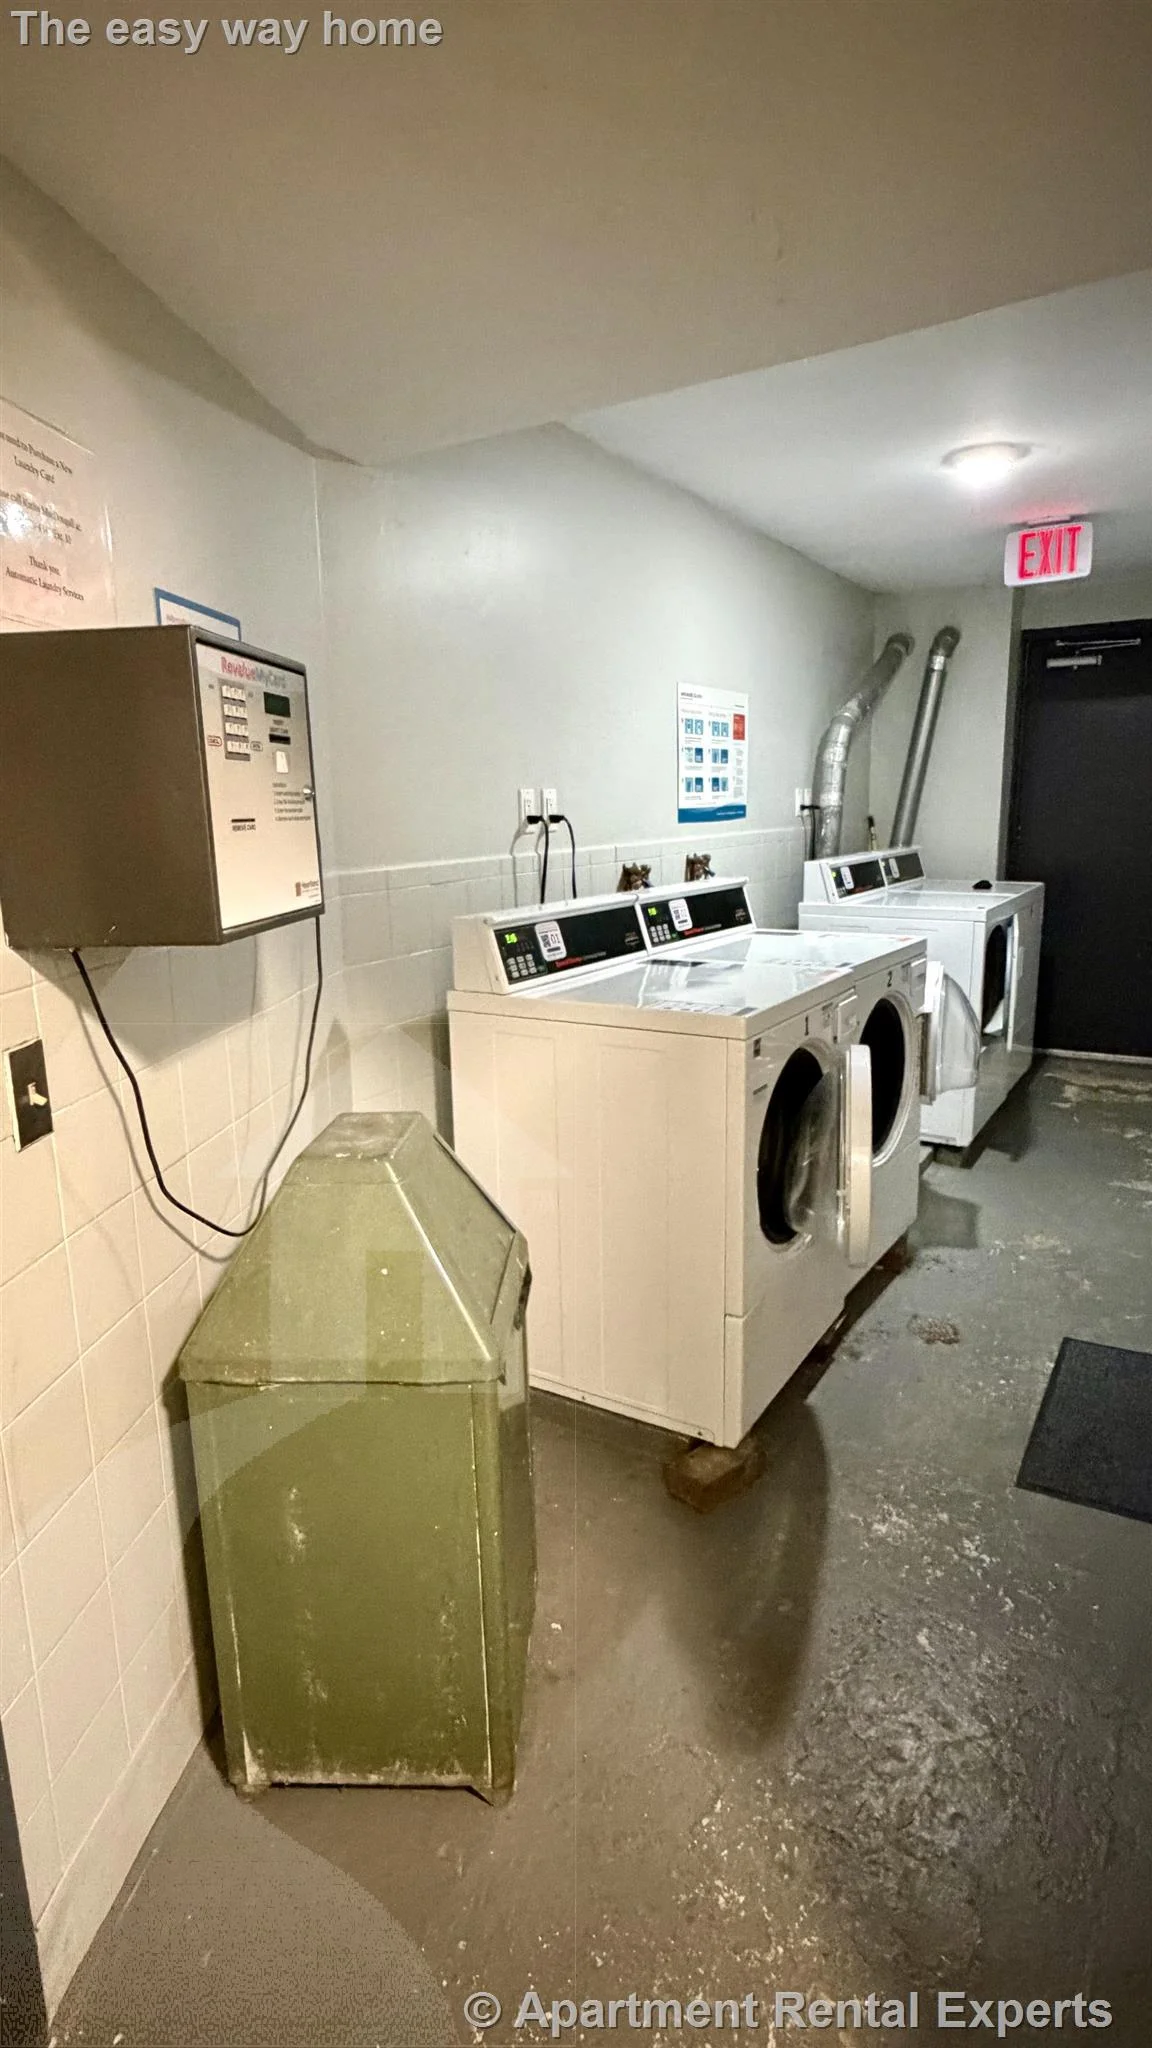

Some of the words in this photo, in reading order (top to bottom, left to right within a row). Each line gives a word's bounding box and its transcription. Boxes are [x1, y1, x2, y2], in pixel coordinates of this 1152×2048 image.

[14, 455, 39, 478] Laundry
[1018, 525, 1083, 580] EXIT
[29, 555, 48, 572] Thank
[6, 566, 38, 586] Automatic
[38, 577, 61, 596] Laundry
[62, 585, 84, 601] Services
[550, 933, 561, 946] 01
[887, 970, 893, 988] 2
[804, 1015, 809, 1036] 1
